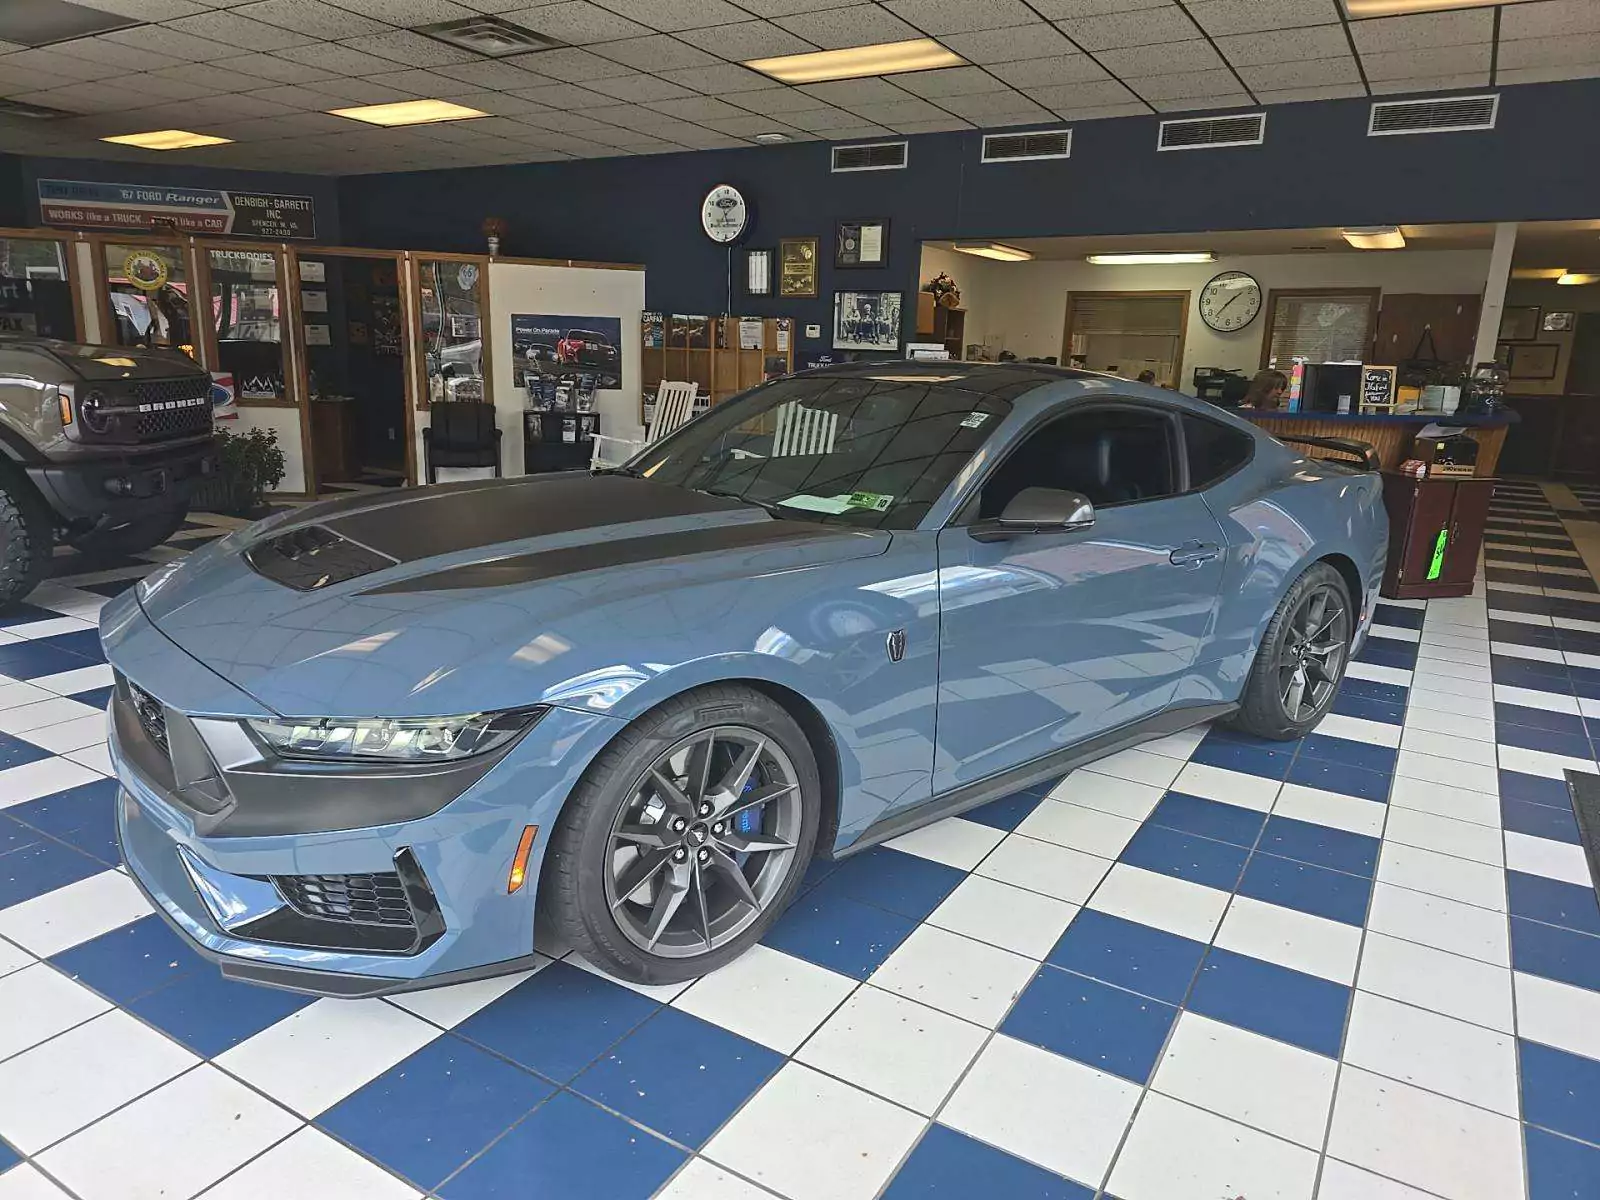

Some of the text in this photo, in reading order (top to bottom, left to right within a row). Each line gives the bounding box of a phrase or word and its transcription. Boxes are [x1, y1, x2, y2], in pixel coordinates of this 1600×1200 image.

[136, 191, 161, 201] FORD
[165, 193, 219, 205] Ranger
[48, 209, 84, 220] WORKS
[86, 212, 102, 221] like
[204, 218, 223, 228] CAR
[210, 250, 273, 261] TRUCKBODIES
[139, 397, 205, 413] BRONCO
